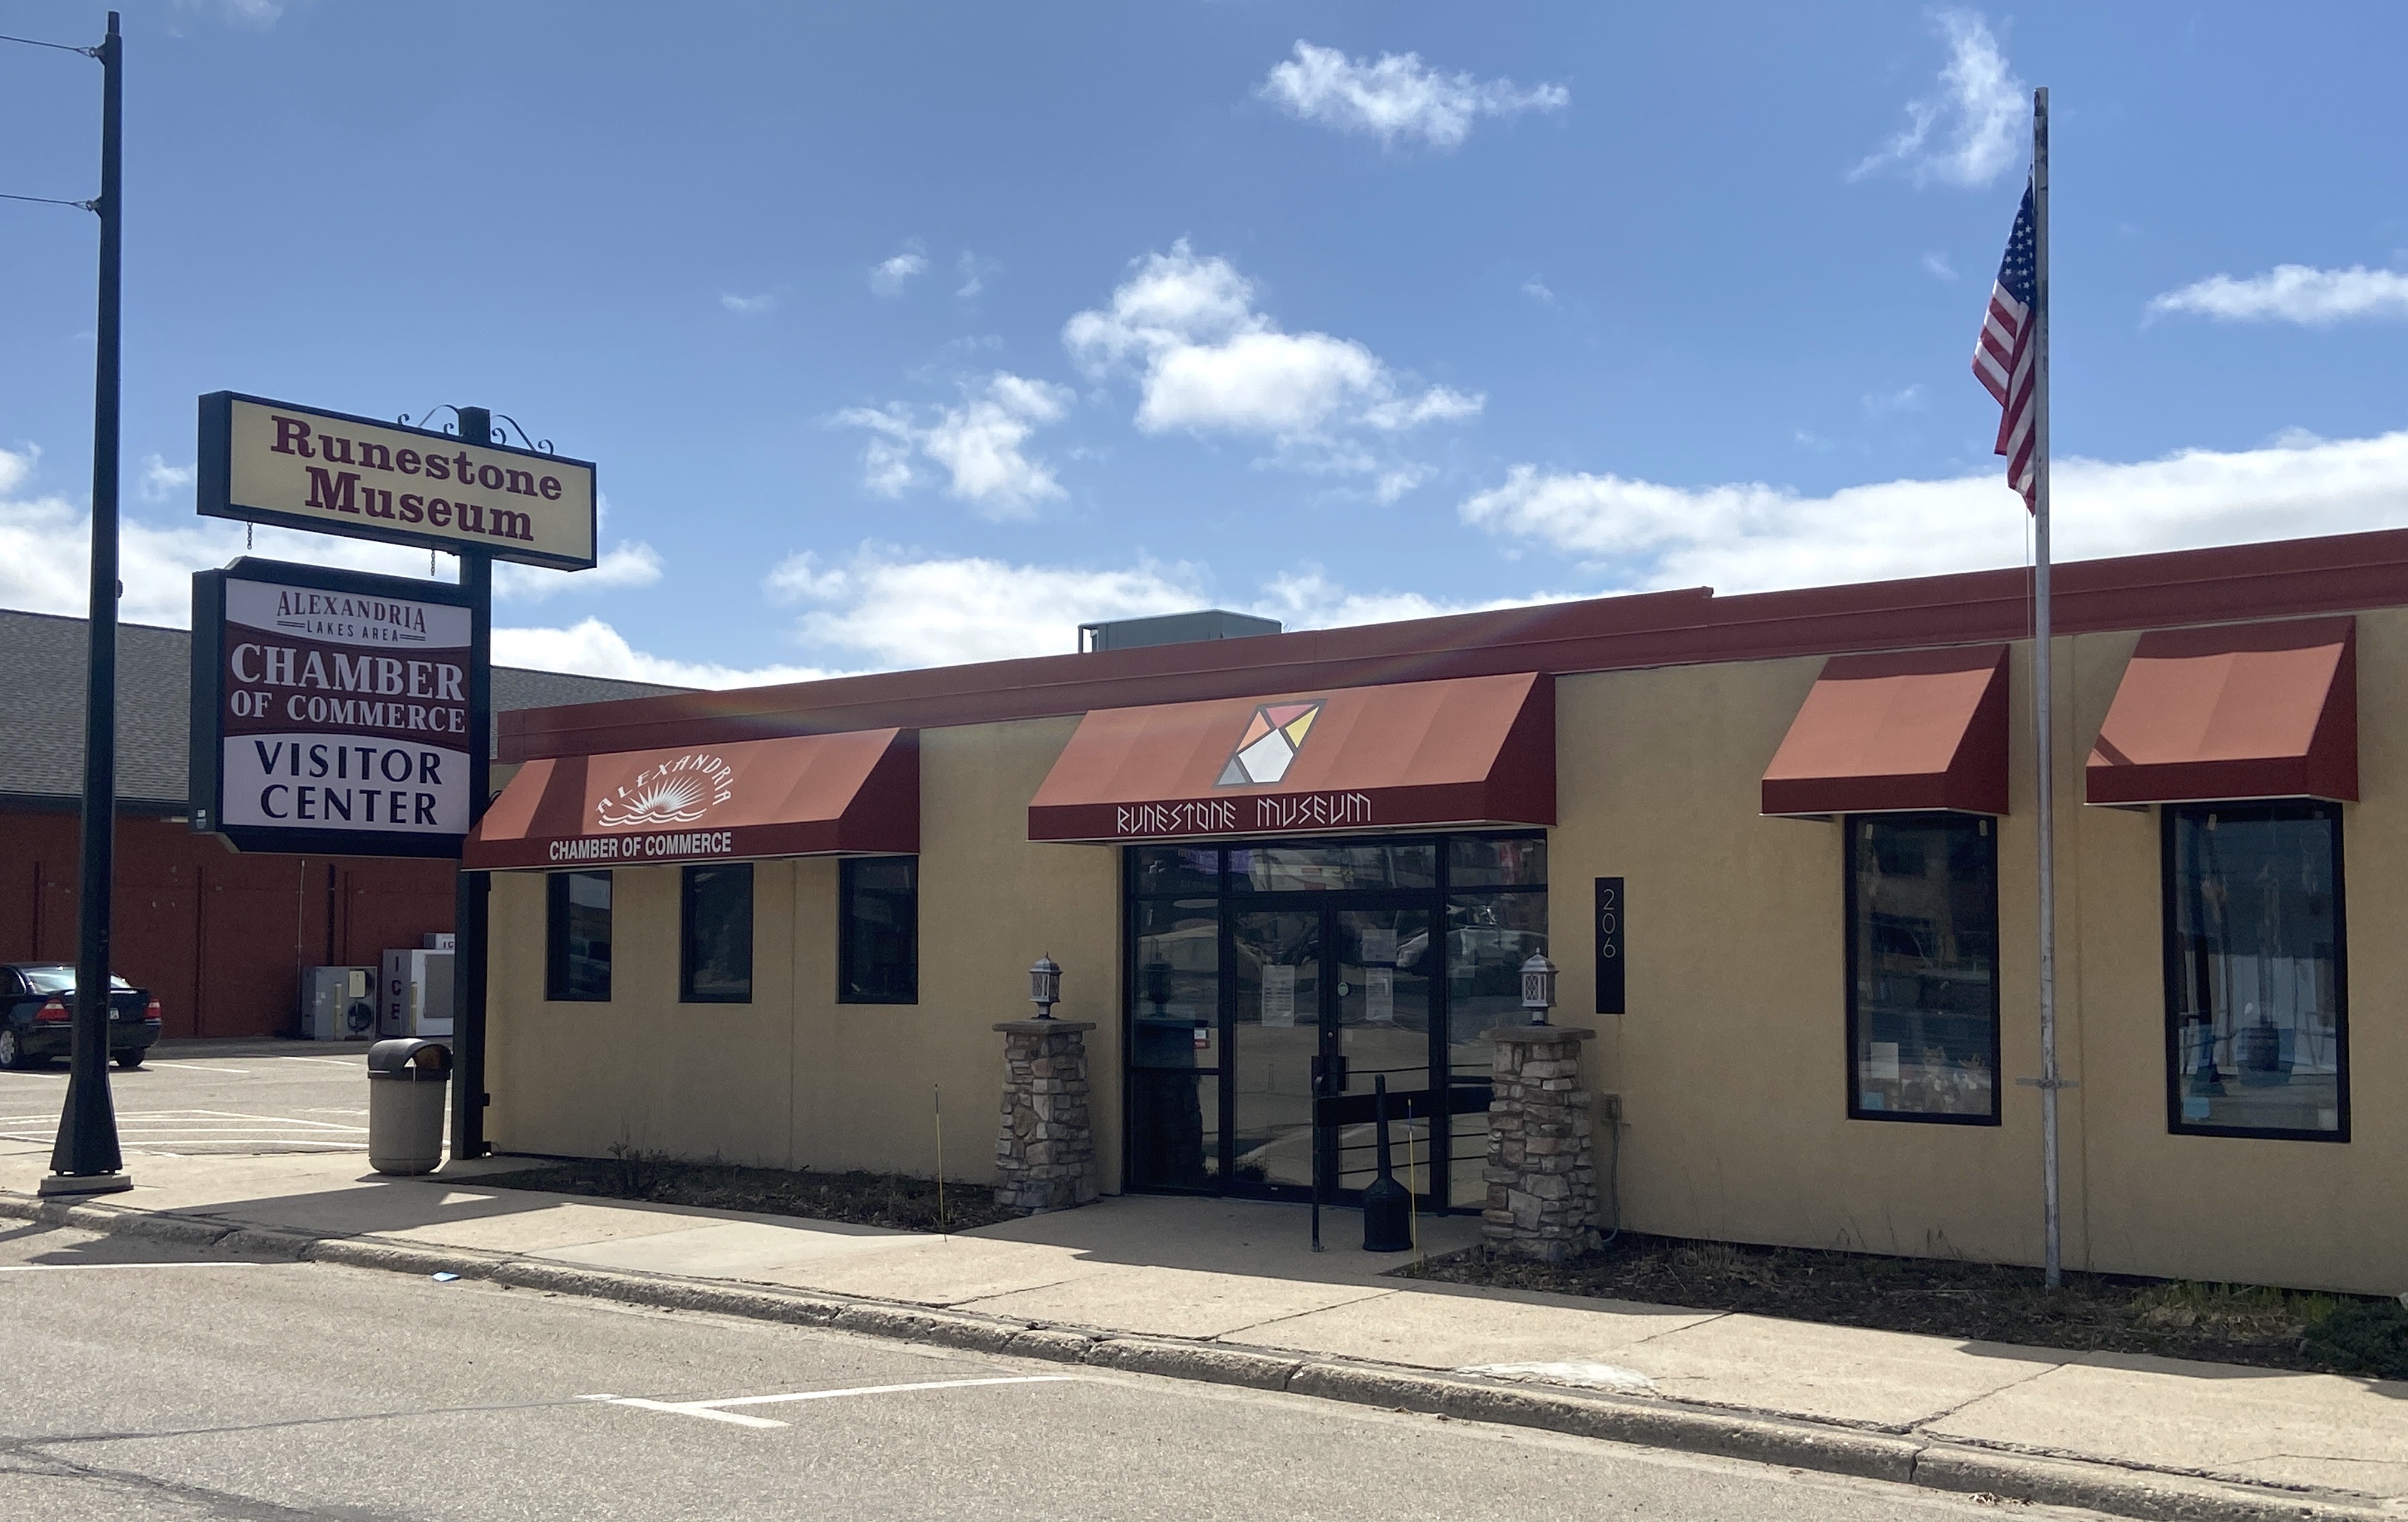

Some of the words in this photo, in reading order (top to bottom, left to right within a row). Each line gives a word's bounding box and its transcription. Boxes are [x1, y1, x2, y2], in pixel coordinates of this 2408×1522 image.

[271, 415, 563, 500] Runestone
[305, 466, 534, 542] Museum
[277, 591, 427, 634] ALEXANDRIA
[306, 620, 354, 638] LAKES
[363, 626, 398, 642] AREA
[231, 642, 465, 702] CHAMBER
[231, 690, 272, 718] OF
[287, 695, 466, 733] COMMERCE
[254, 740, 443, 785] VISITOR
[595, 753, 734, 814] ALEXANDRIA
[260, 784, 438, 826] CENTER
[1117, 800, 1236, 835] RUNESTONE
[1257, 792, 1371, 828] MUSEUM
[549, 838, 618, 860] CHAMBER
[622, 837, 641, 857] OF
[645, 832, 732, 856] COMMERCE
[1602, 888, 1616, 958] 206
[391, 956, 402, 1020] ICE
